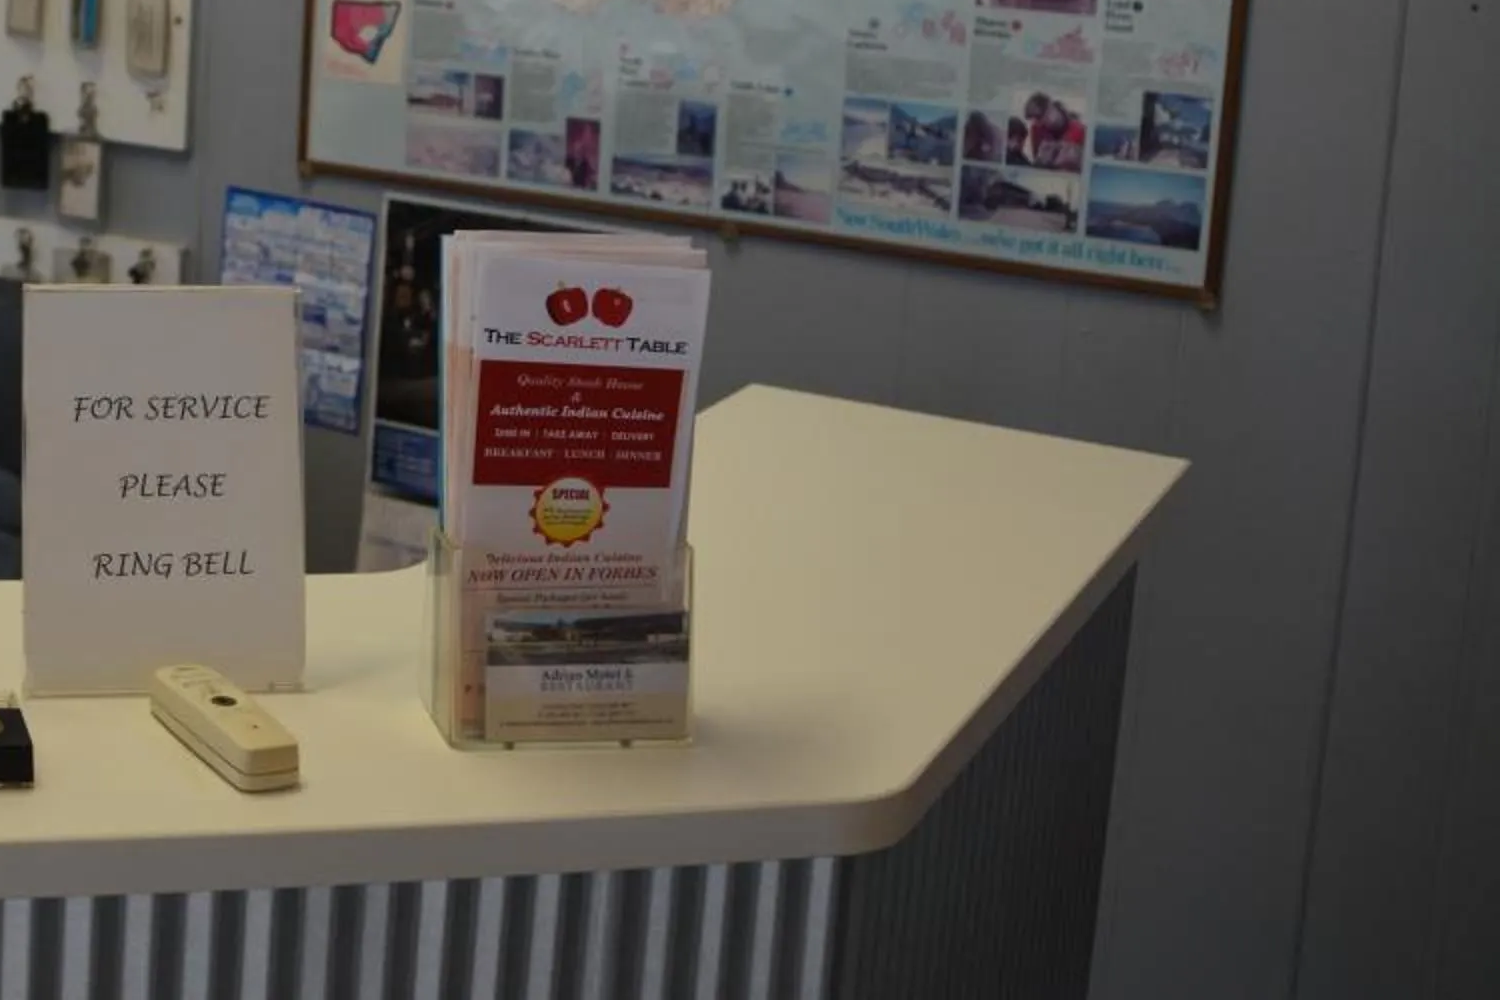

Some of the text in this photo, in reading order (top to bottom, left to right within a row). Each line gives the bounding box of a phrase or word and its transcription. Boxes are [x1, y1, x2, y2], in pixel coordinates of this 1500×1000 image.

[484, 327, 690, 355] THE SCARLETT TABLE
[73, 394, 271, 423] FOR SERVICE
[490, 403, 665, 422] Authentic Indian Cuisine
[119, 472, 228, 500] PLEASE
[92, 550, 256, 581] RING BELL
[467, 565, 658, 584] NOW OPEN IN FORBES
